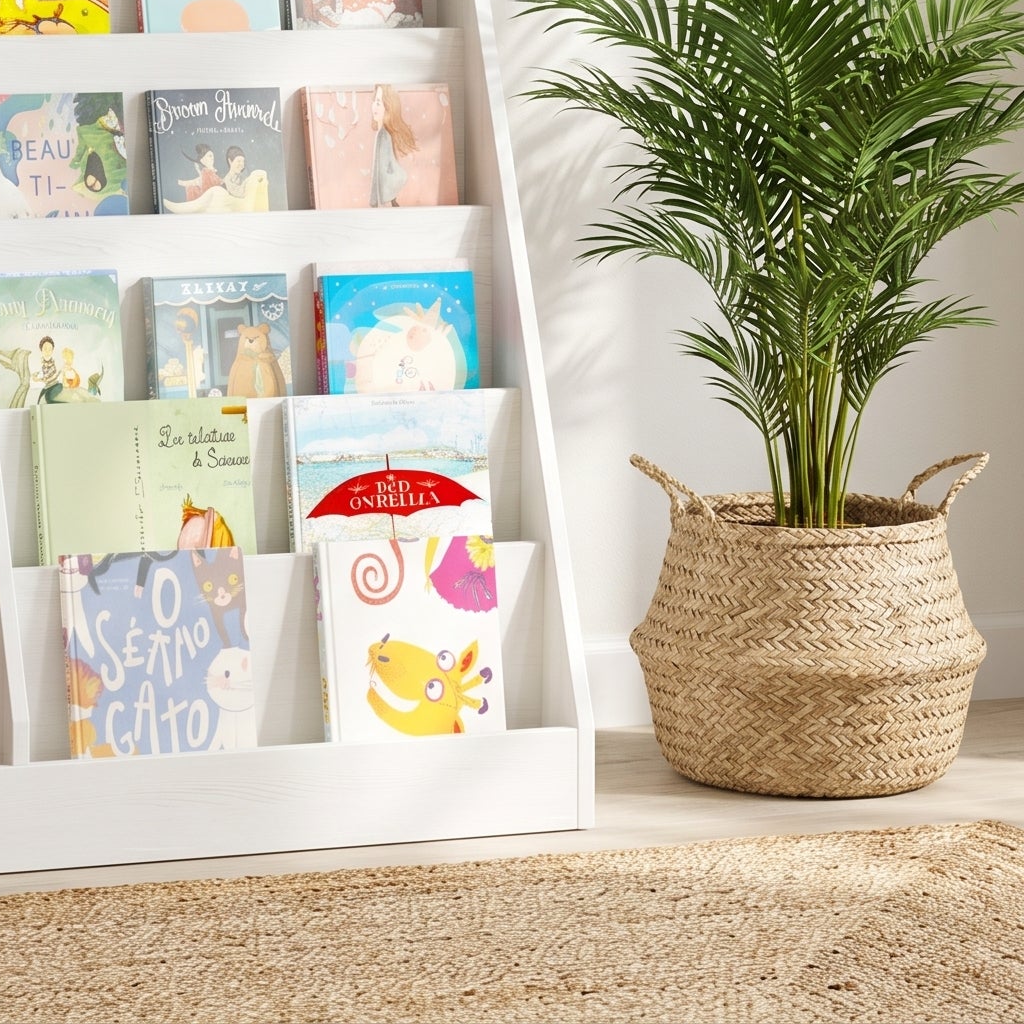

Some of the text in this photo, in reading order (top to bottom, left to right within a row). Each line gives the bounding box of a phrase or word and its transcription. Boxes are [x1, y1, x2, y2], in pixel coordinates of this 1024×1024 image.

[11, 140, 71, 161] BEAU
[29, 175, 67, 196] TI-
[152, 567, 182, 629] O
